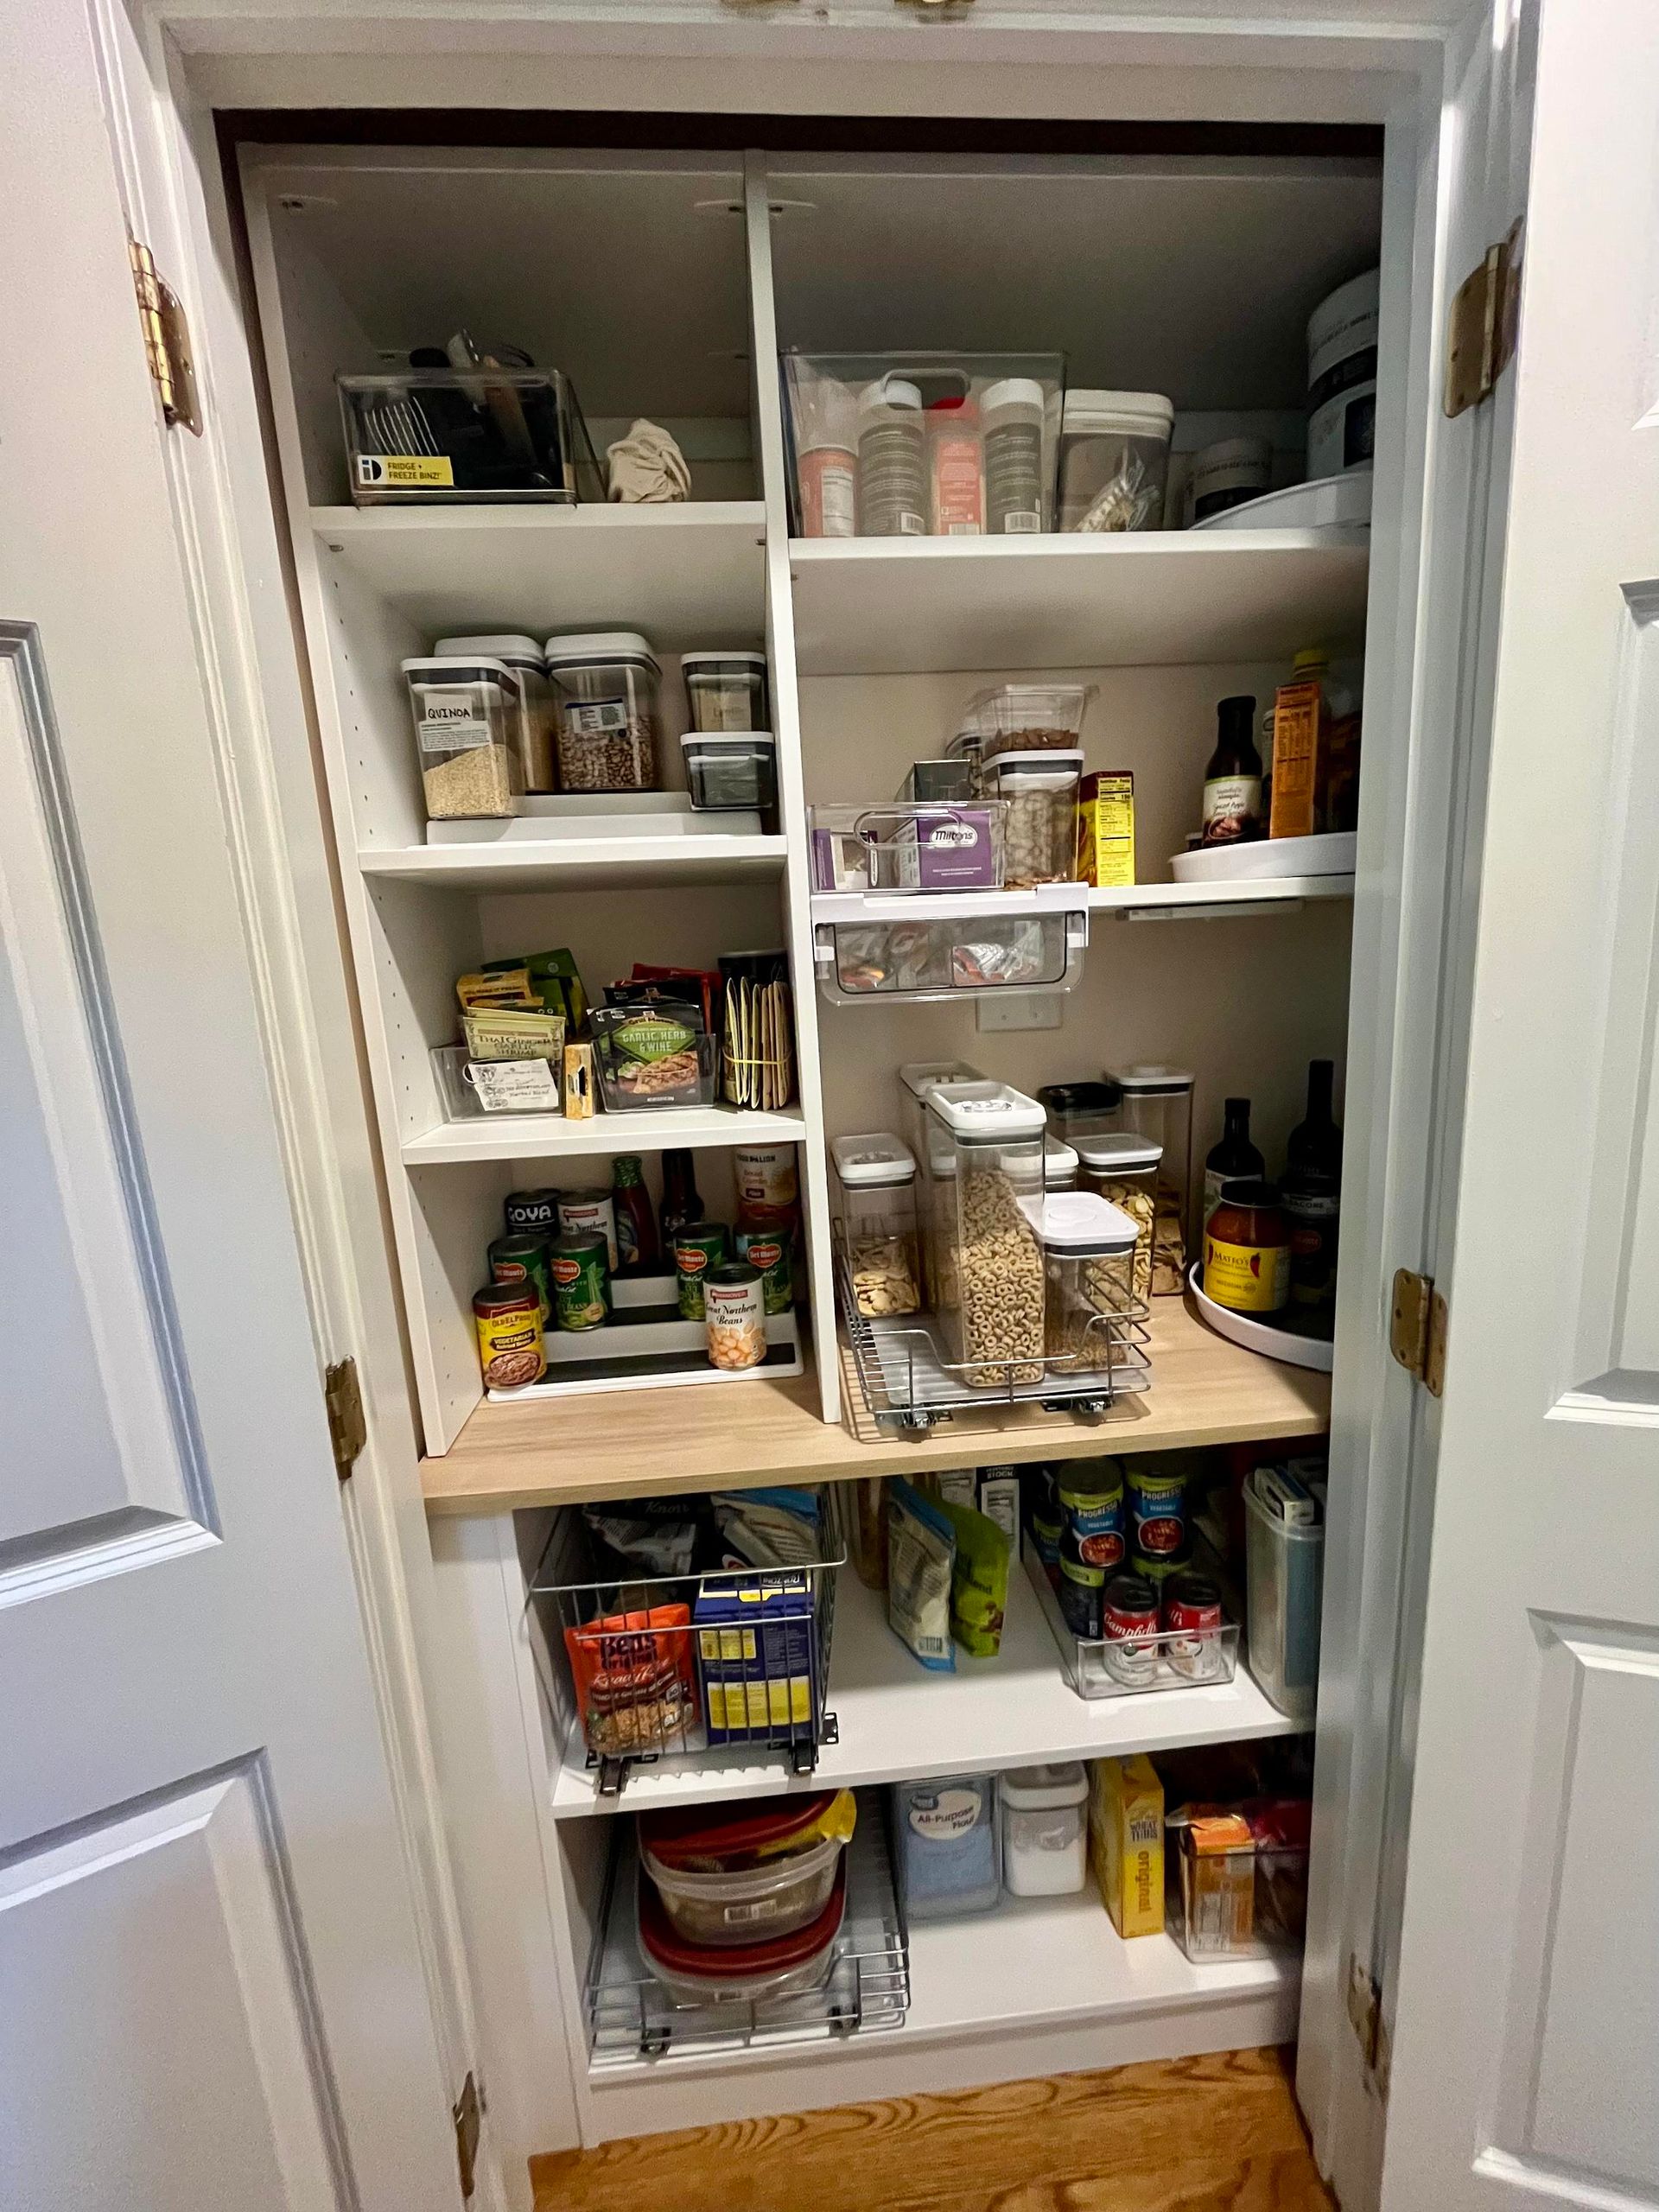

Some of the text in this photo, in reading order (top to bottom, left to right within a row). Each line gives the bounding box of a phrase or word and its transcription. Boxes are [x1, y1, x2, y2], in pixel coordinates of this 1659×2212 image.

[387, 461, 416, 470] FRIDGE
[428, 708, 471, 719] QUINOA
[660, 1031, 686, 1039] HERB
[647, 1042, 672, 1052] WINE
[759, 1154, 776, 1163] LION
[508, 1205, 552, 1222] GOYA
[722, 1303, 758, 1316] Northern
[717, 1314, 743, 1325] Beans
